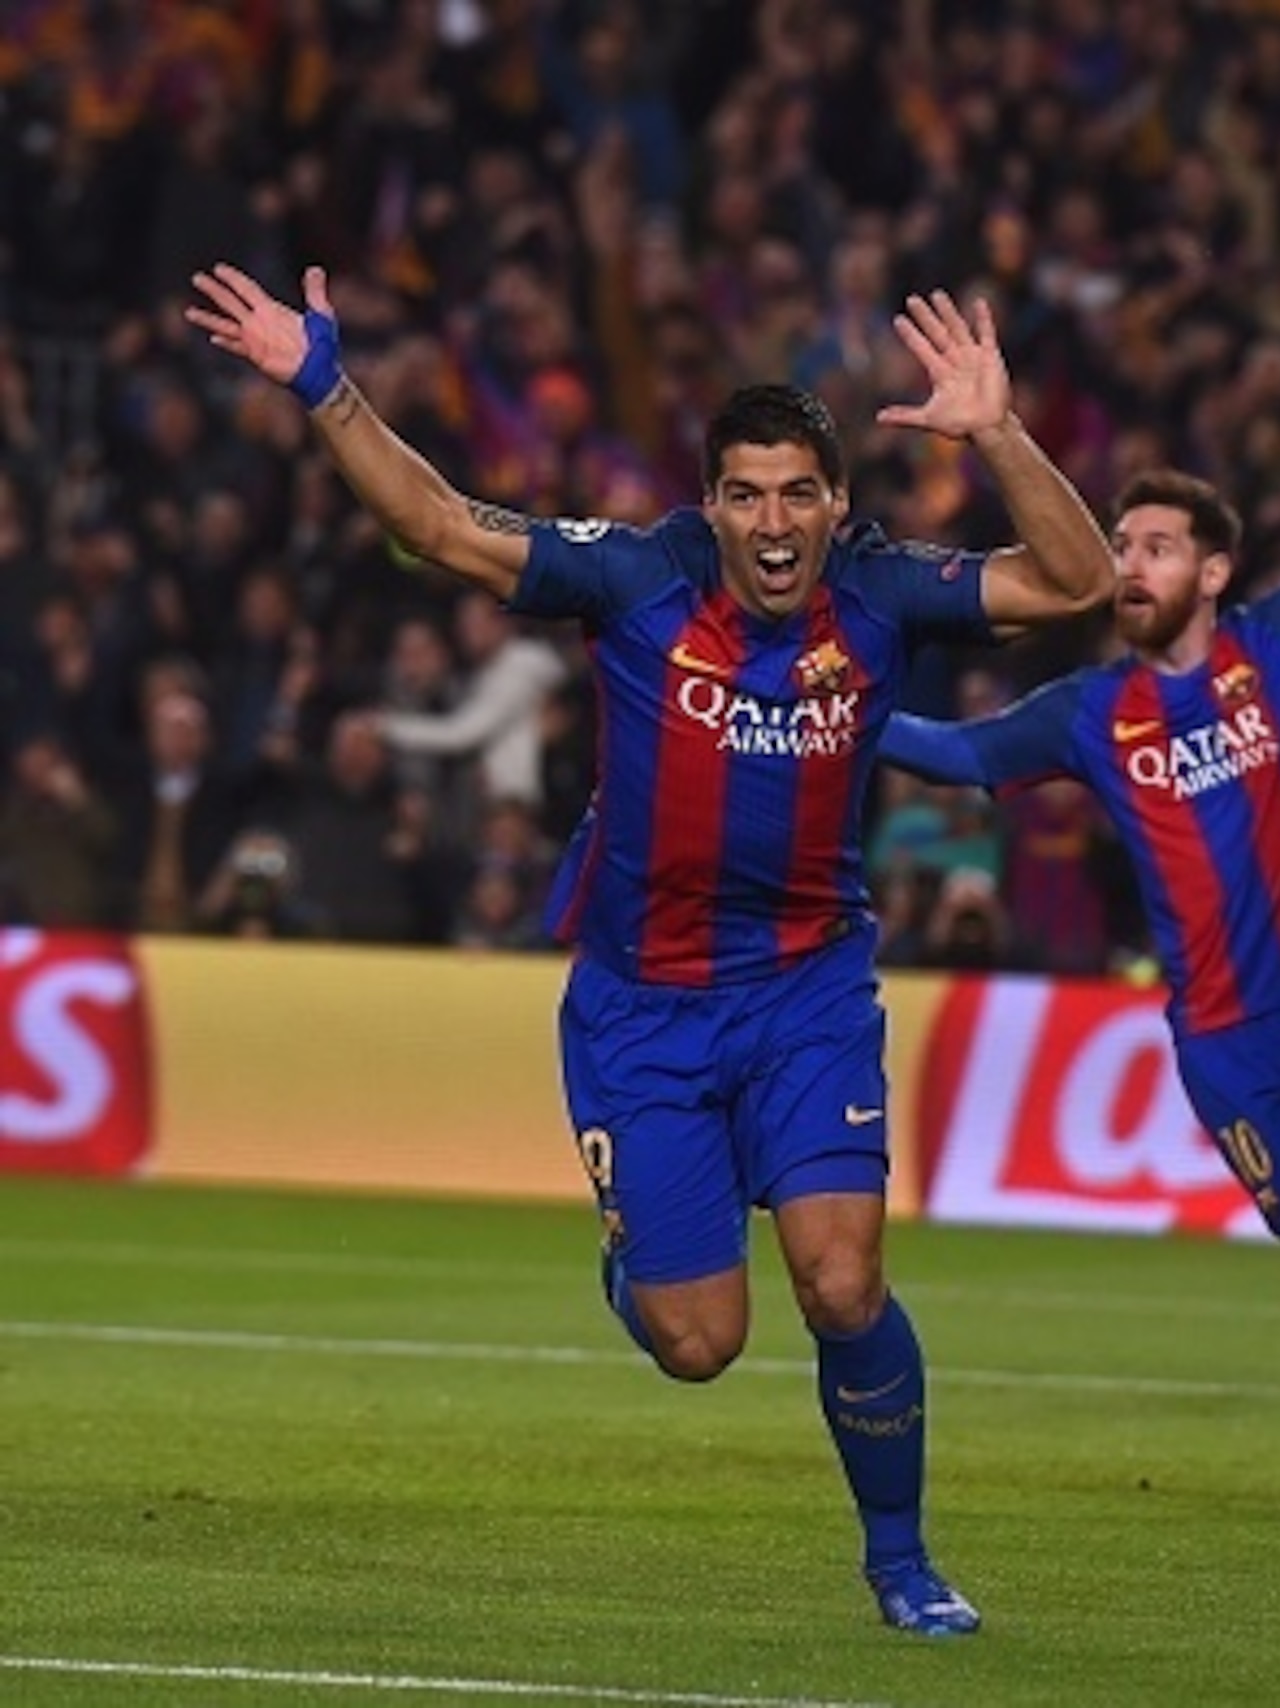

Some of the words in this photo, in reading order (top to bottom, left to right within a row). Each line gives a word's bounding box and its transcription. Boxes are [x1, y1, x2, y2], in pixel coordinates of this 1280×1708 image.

[677, 676, 860, 729] QATAR
[1127, 702, 1271, 789] QATAR
[1219, 1117, 1273, 1187] 10
